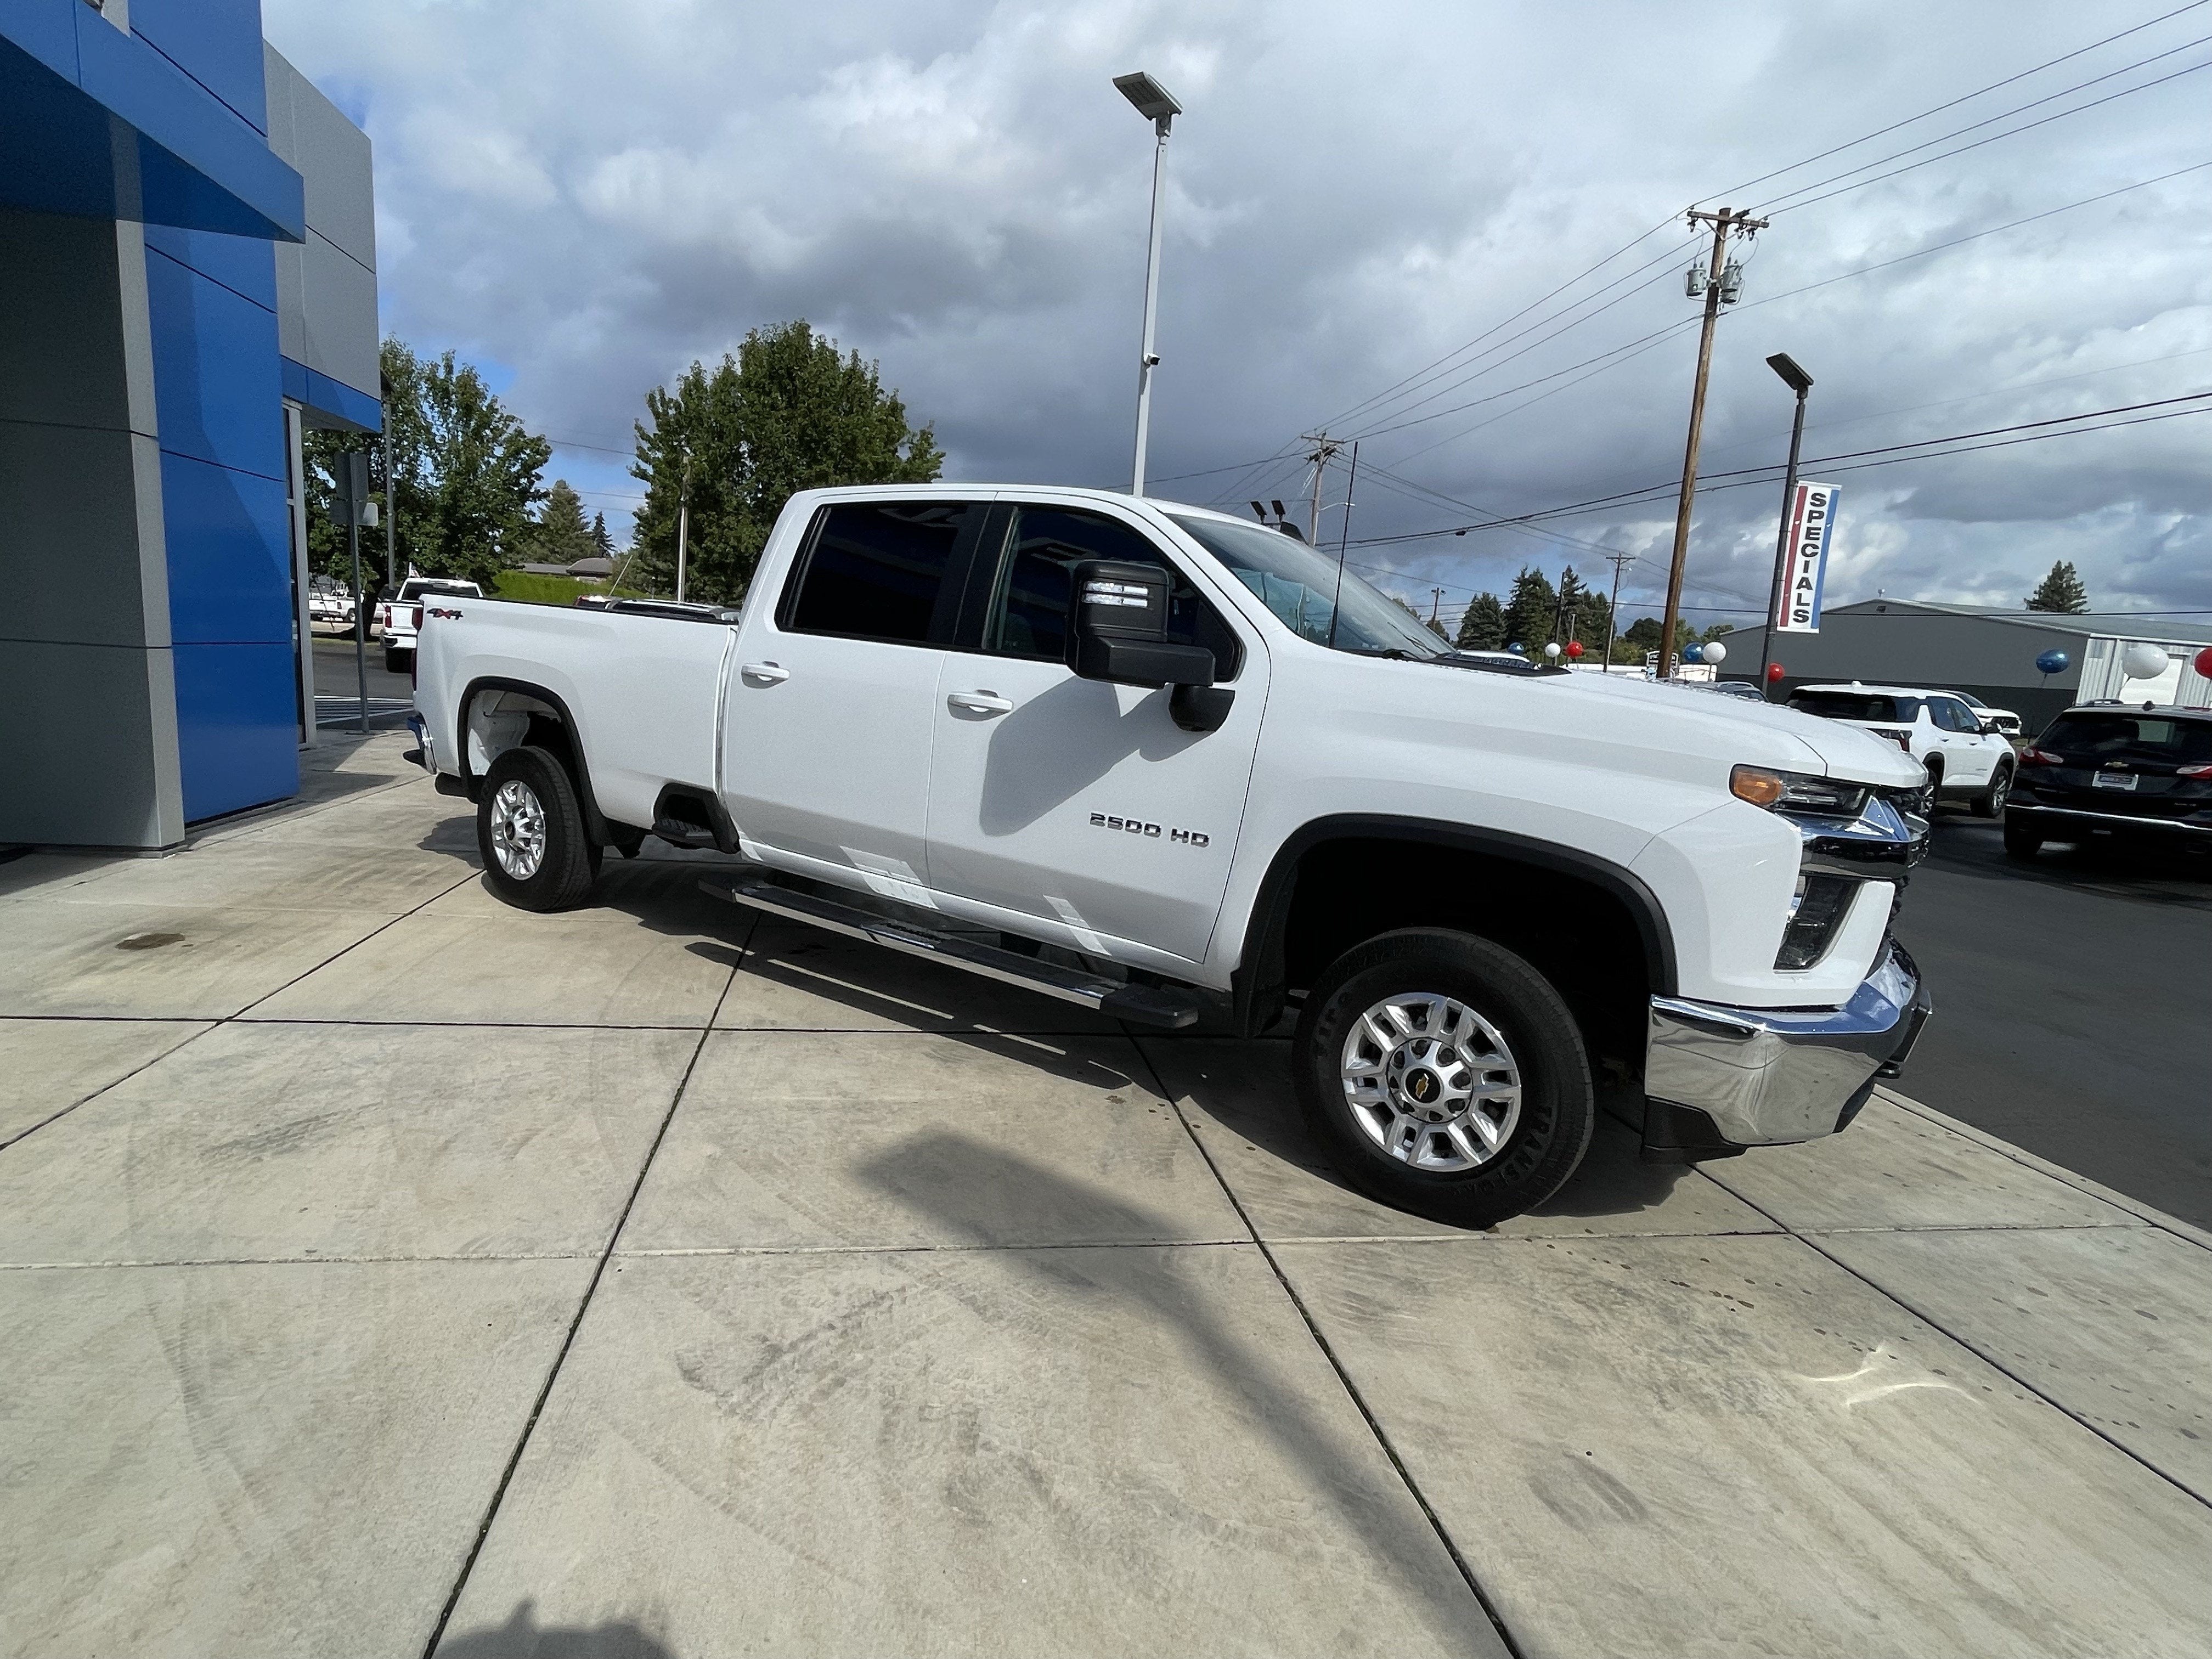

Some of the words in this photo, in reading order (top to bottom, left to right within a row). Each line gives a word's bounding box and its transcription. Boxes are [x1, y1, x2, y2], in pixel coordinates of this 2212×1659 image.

[1793, 493, 1827, 623] SPECIALS
[1090, 812, 1161, 838] 2500
[1170, 828, 1210, 848] HD
